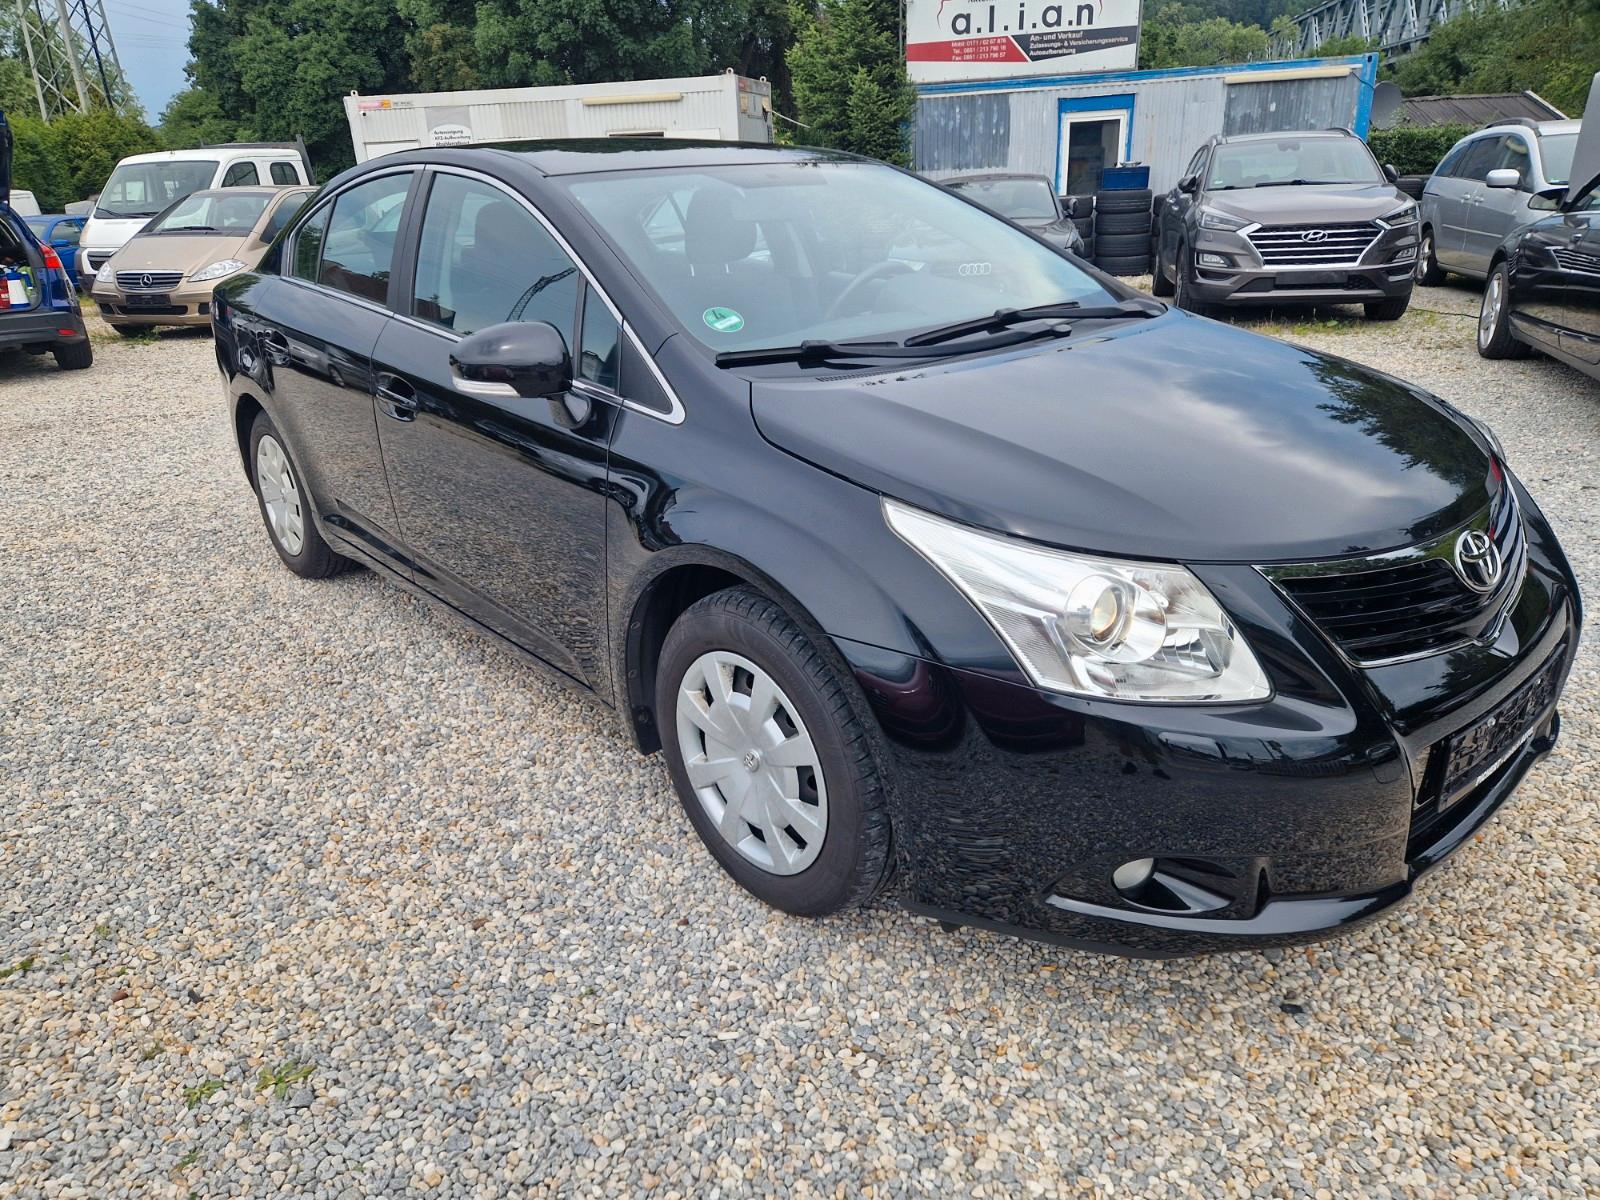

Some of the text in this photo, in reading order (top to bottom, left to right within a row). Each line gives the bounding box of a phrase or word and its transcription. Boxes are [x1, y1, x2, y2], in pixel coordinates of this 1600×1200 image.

[951, 3, 1094, 35] a.l.i.a.n
[1030, 31, 1083, 42] An- und Verkauf
